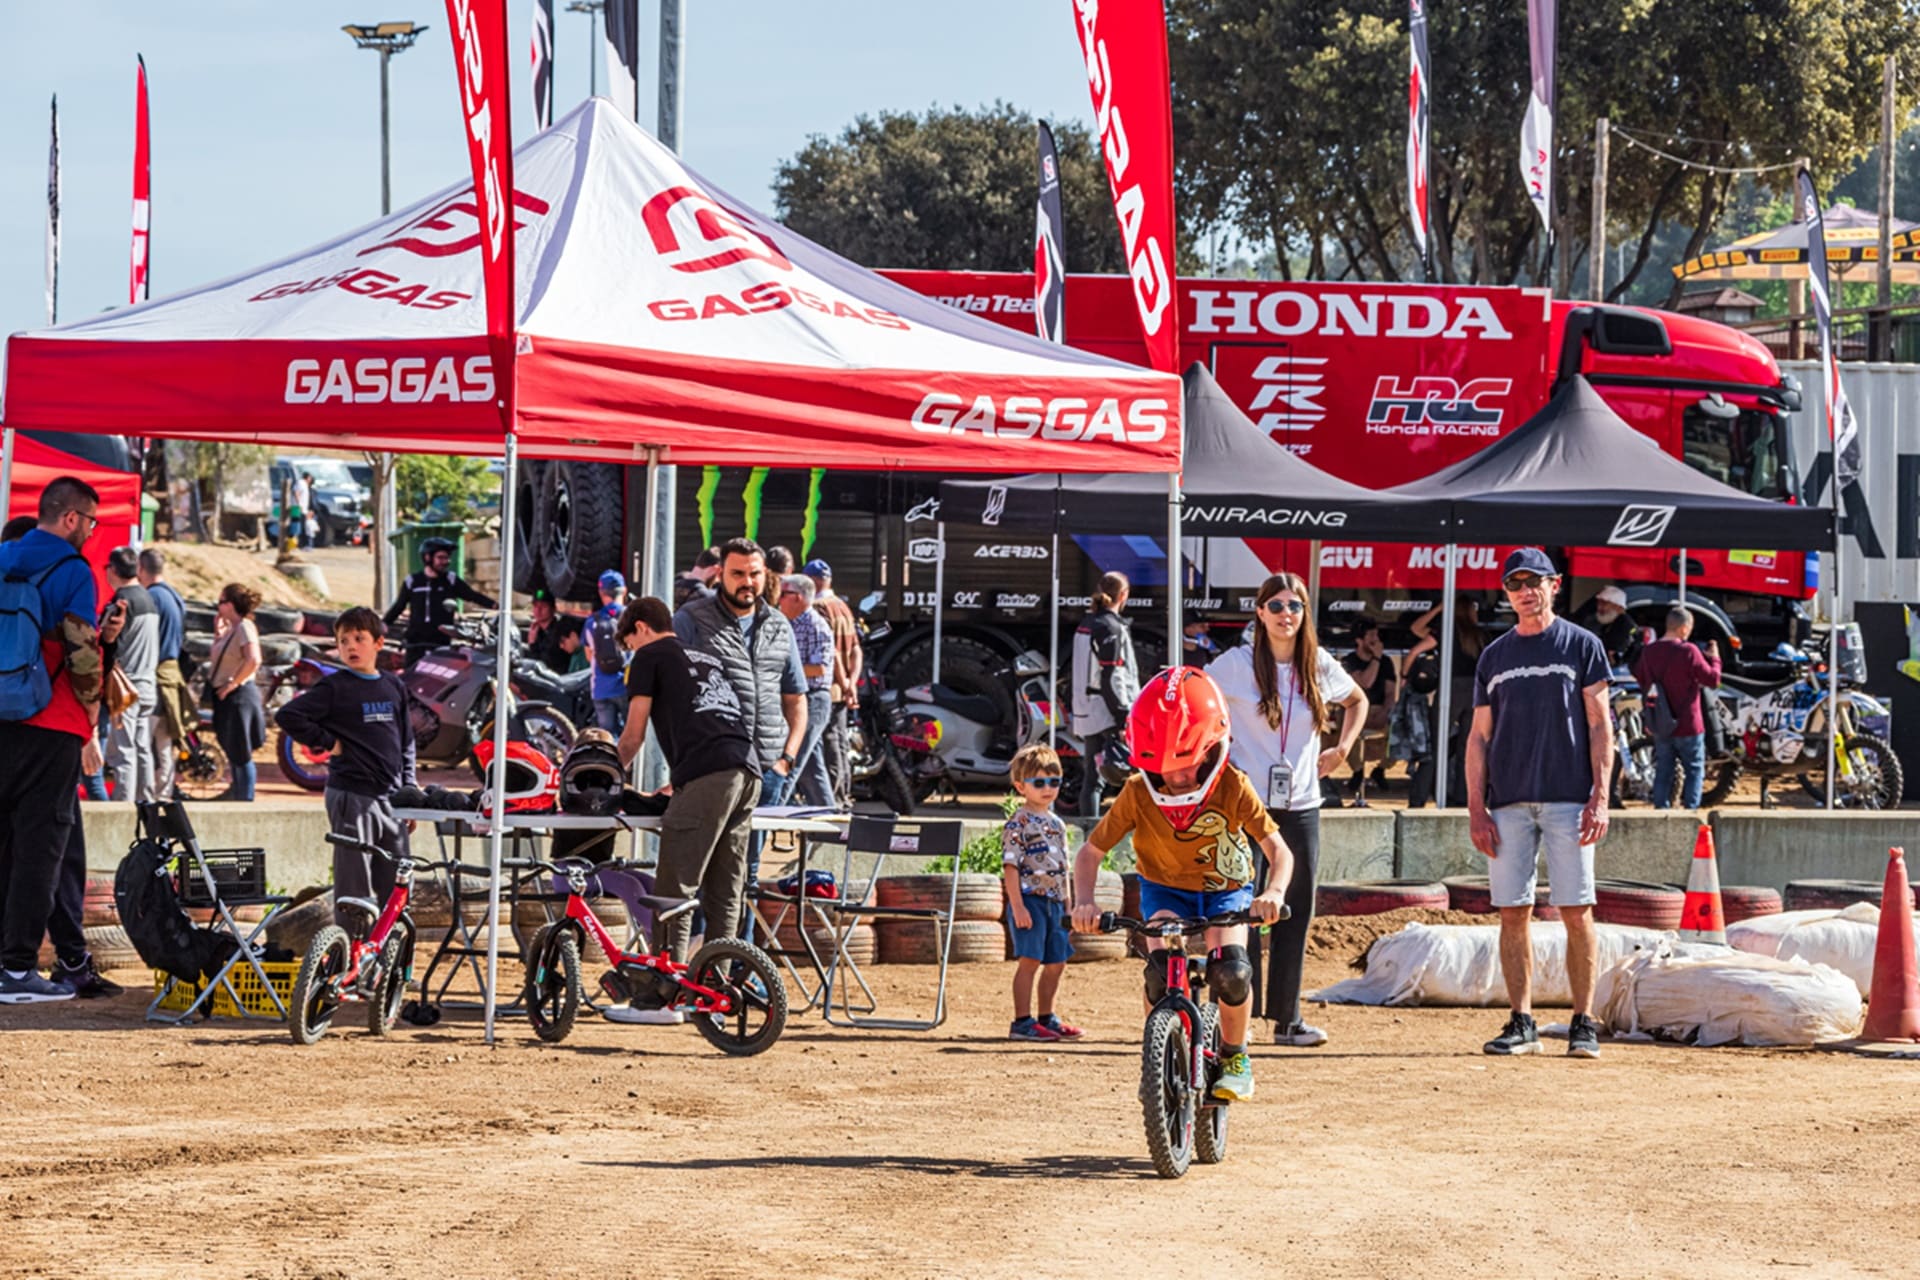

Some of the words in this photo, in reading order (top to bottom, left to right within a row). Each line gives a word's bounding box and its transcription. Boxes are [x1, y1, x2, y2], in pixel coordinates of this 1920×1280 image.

[248, 267, 473, 310] GASGAS
[646, 281, 911, 331] GASGAS
[992, 294, 1036, 313] Tea
[1188, 290, 1513, 340] HONDA
[284, 356, 496, 404] GASGAS
[1366, 376, 1513, 425] HRC
[910, 392, 1169, 443] GASGAS
[1366, 424, 1429, 435] Honda
[1432, 424, 1500, 436] RACING
[973, 545, 1049, 559] ACERBIS
[1319, 546, 1373, 568] GIVI
[361, 701, 394, 714] RAMS
